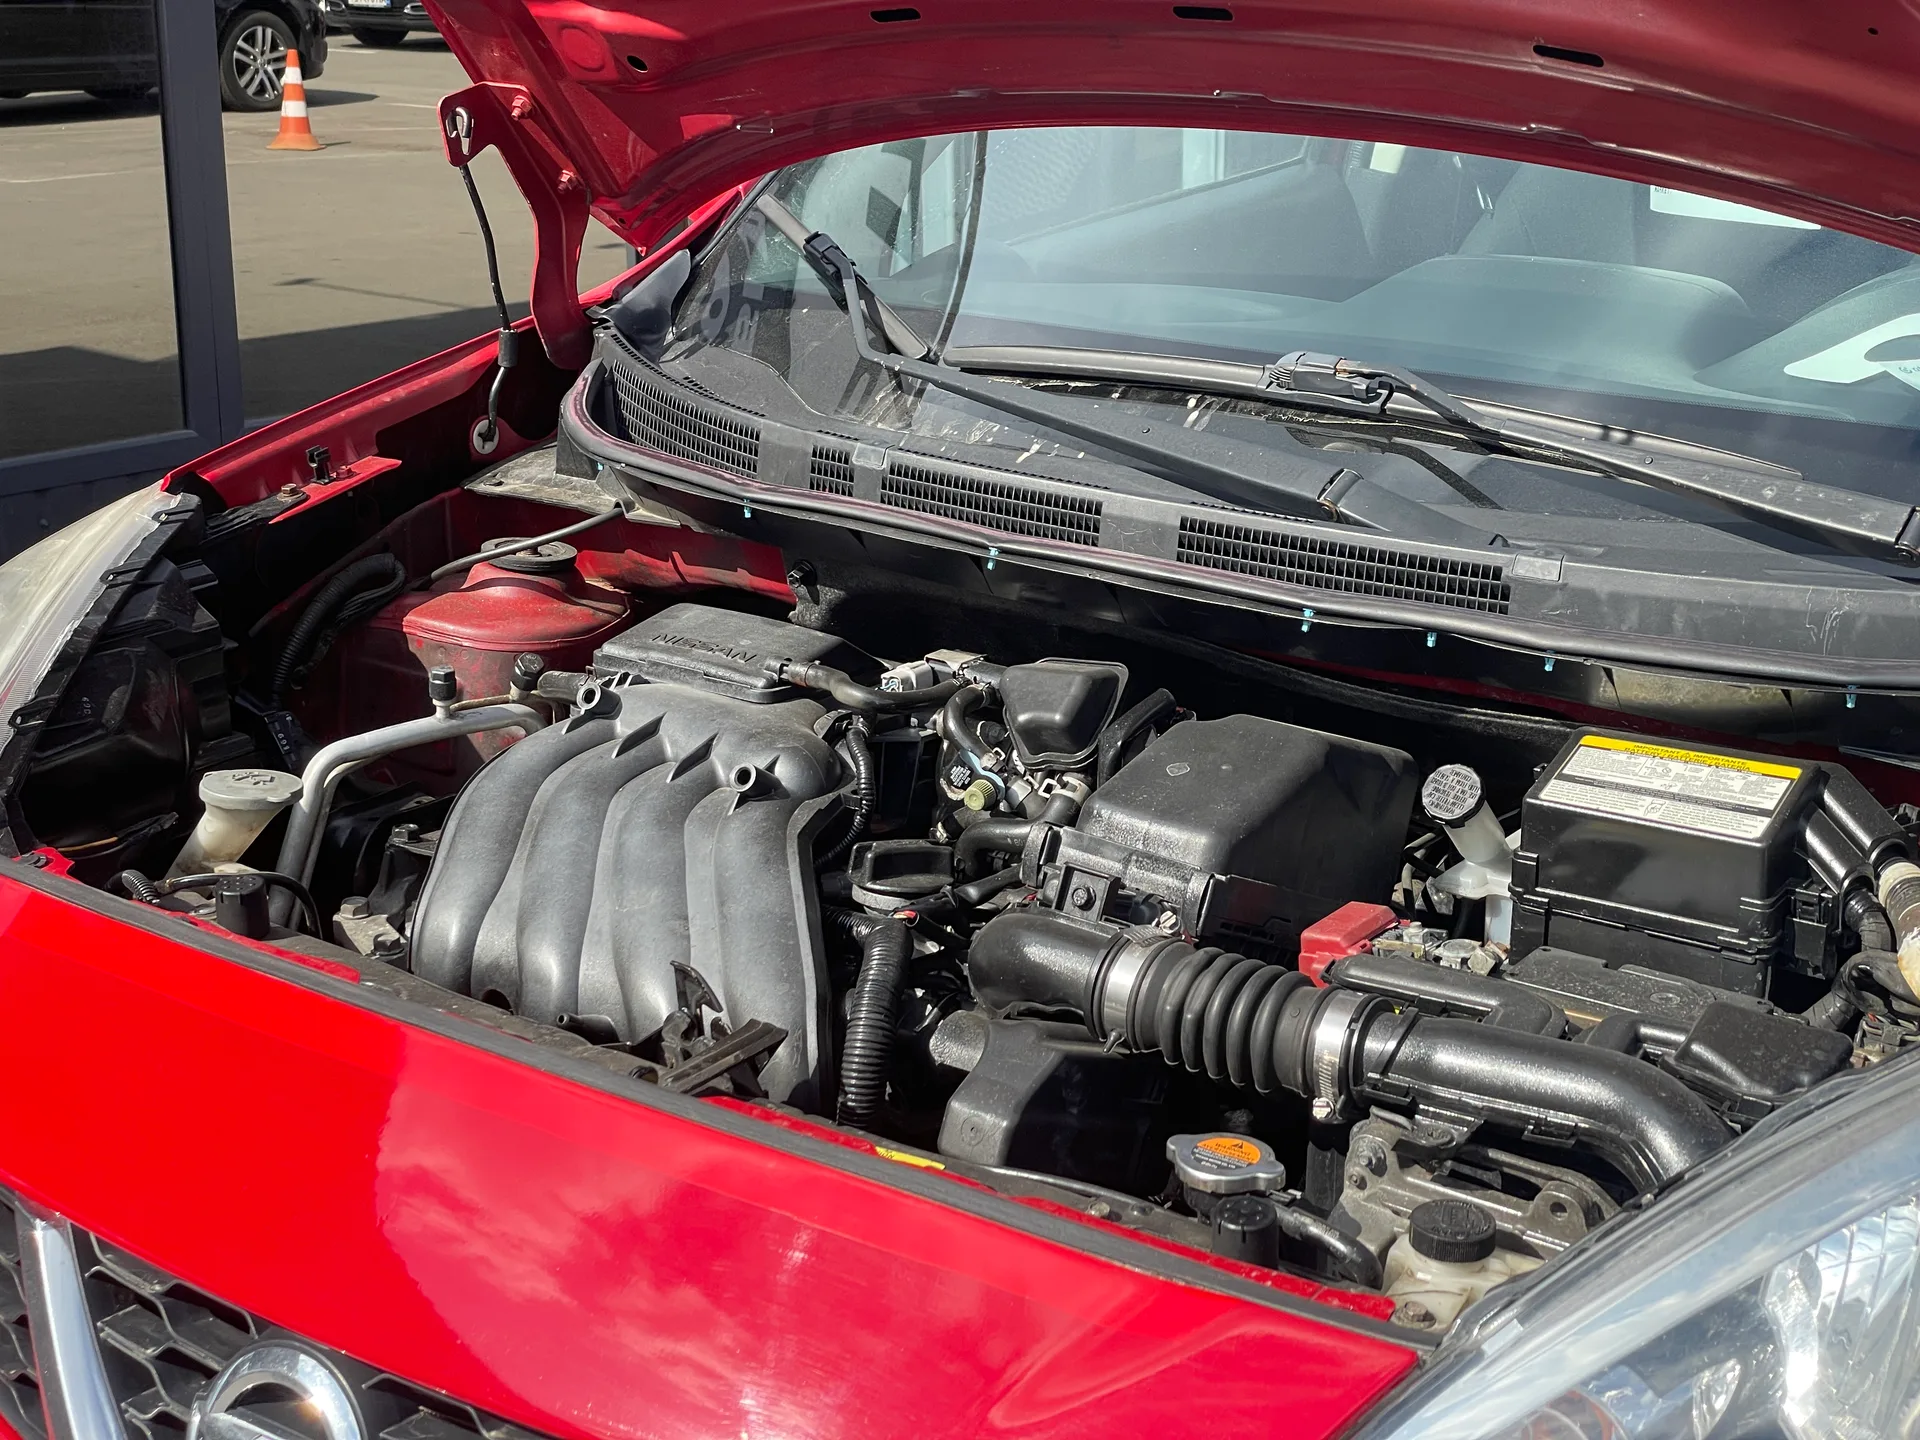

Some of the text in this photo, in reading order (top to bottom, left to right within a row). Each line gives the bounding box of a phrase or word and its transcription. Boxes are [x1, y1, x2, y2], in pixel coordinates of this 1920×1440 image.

[652, 634, 757, 662] NISSAN
[1624, 747, 1661, 758] BATTERY
[1666, 754, 1708, 766] BATTERIE
[1633, 744, 1748, 766] IMPORTANT IMPORTANTE
[1215, 1142, 1251, 1156] WARNING
